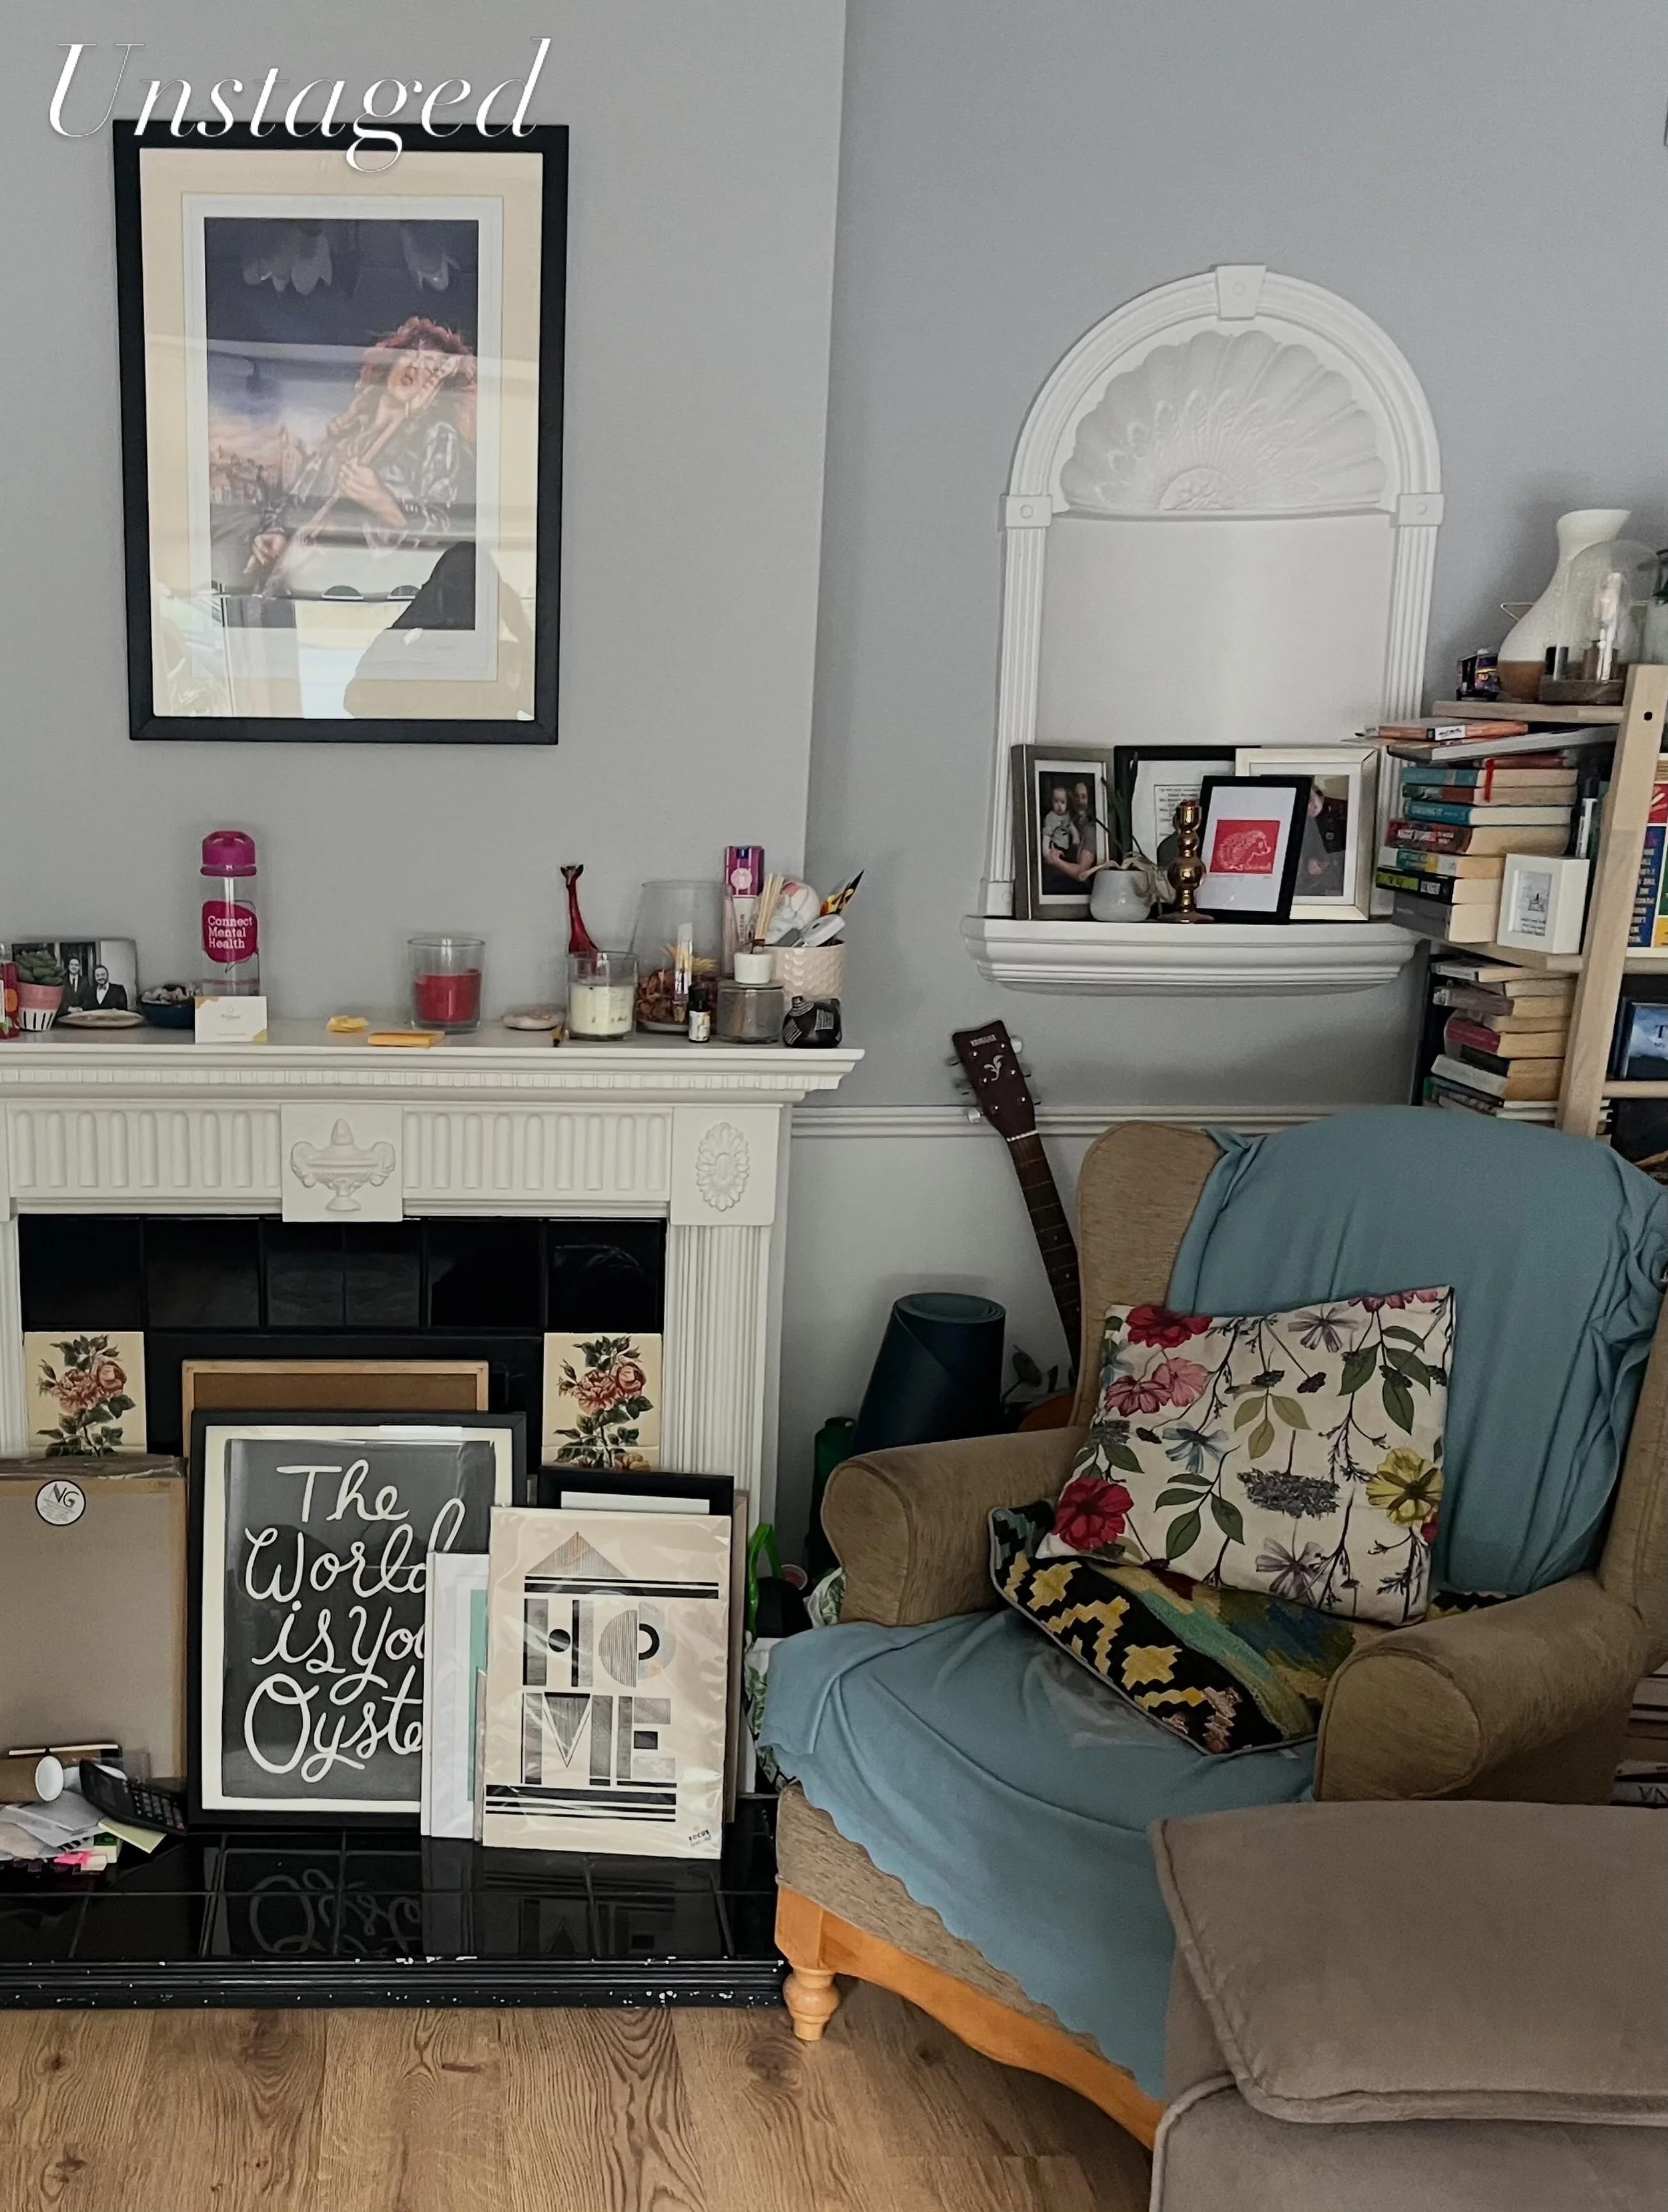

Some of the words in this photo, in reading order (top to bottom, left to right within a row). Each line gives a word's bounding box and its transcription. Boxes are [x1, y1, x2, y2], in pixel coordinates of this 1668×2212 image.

[207, 915, 253, 927] Connect
[208, 927, 246, 938] Mental
[208, 938, 246, 949] Health
[48, 1483, 79, 1508] NG
[276, 1458, 410, 1523] The
[251, 1600, 346, 1674] is
[522, 1598, 676, 1688] HO
[520, 1692, 677, 1788] ME
